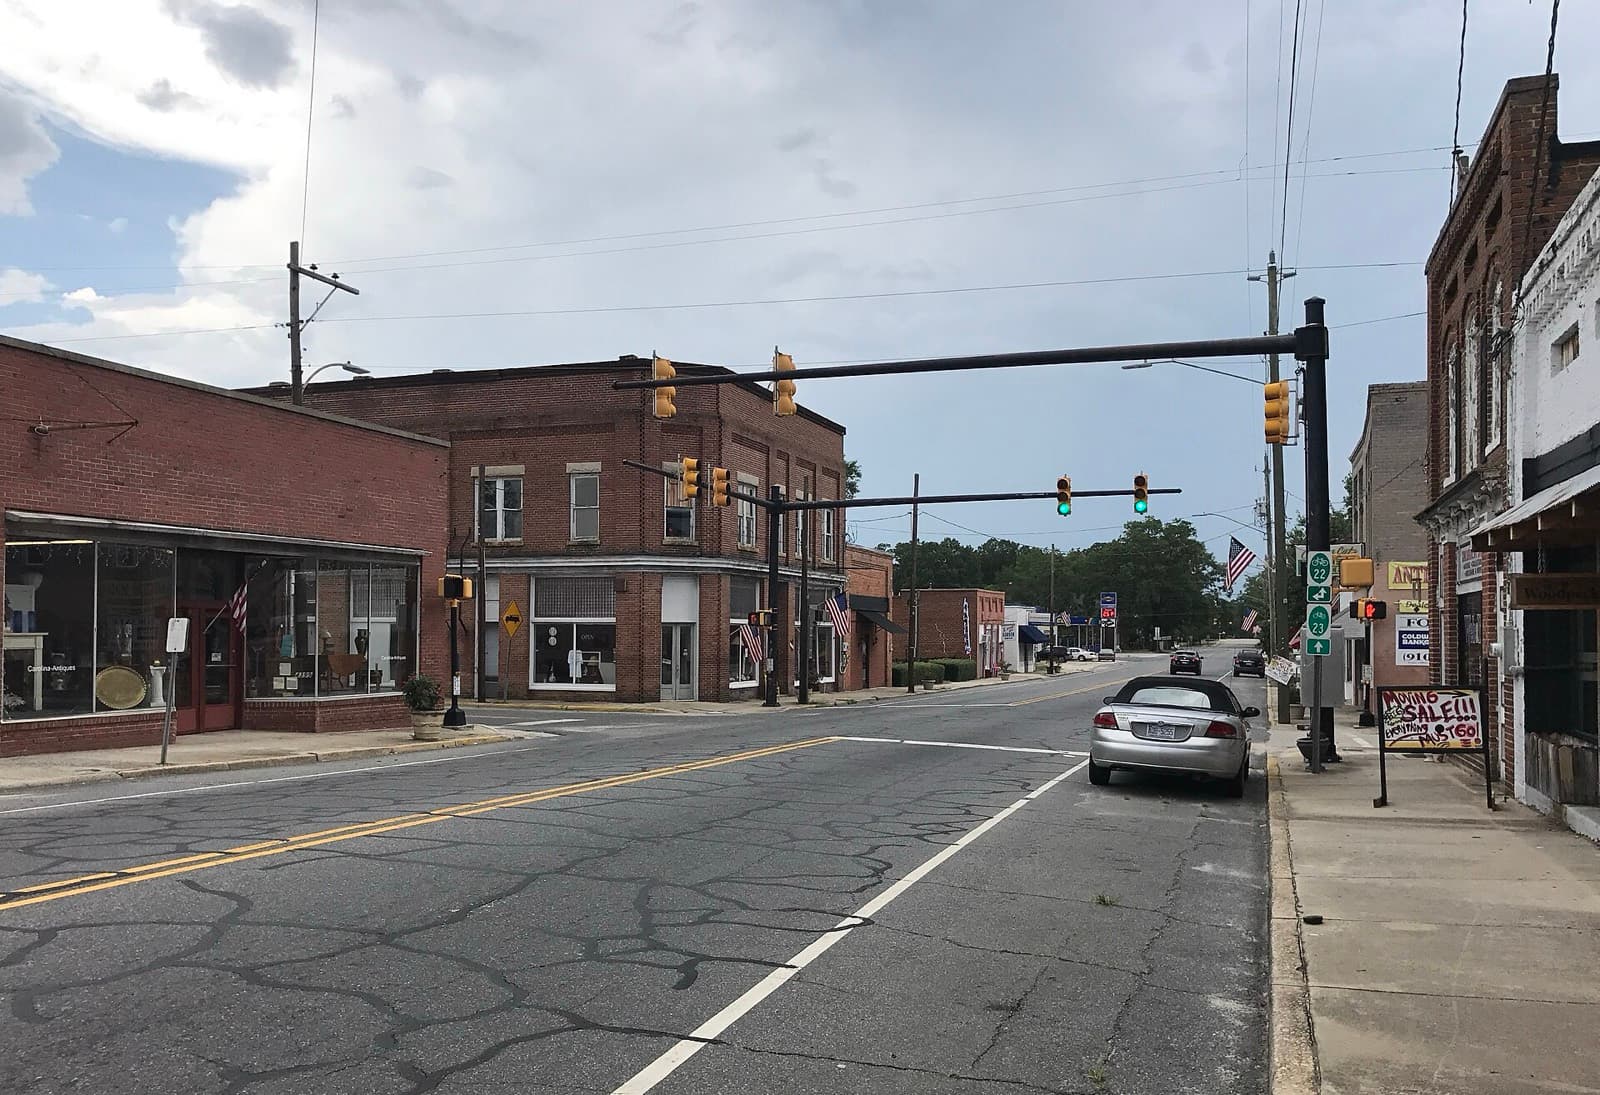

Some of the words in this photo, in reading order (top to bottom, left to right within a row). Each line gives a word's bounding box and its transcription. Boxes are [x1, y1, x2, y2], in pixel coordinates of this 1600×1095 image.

[1313, 568, 1326, 580] 22
[1312, 622, 1324, 634] 23
[1383, 690, 1438, 708] MOVING
[1402, 698, 1477, 722] SALE!!!
